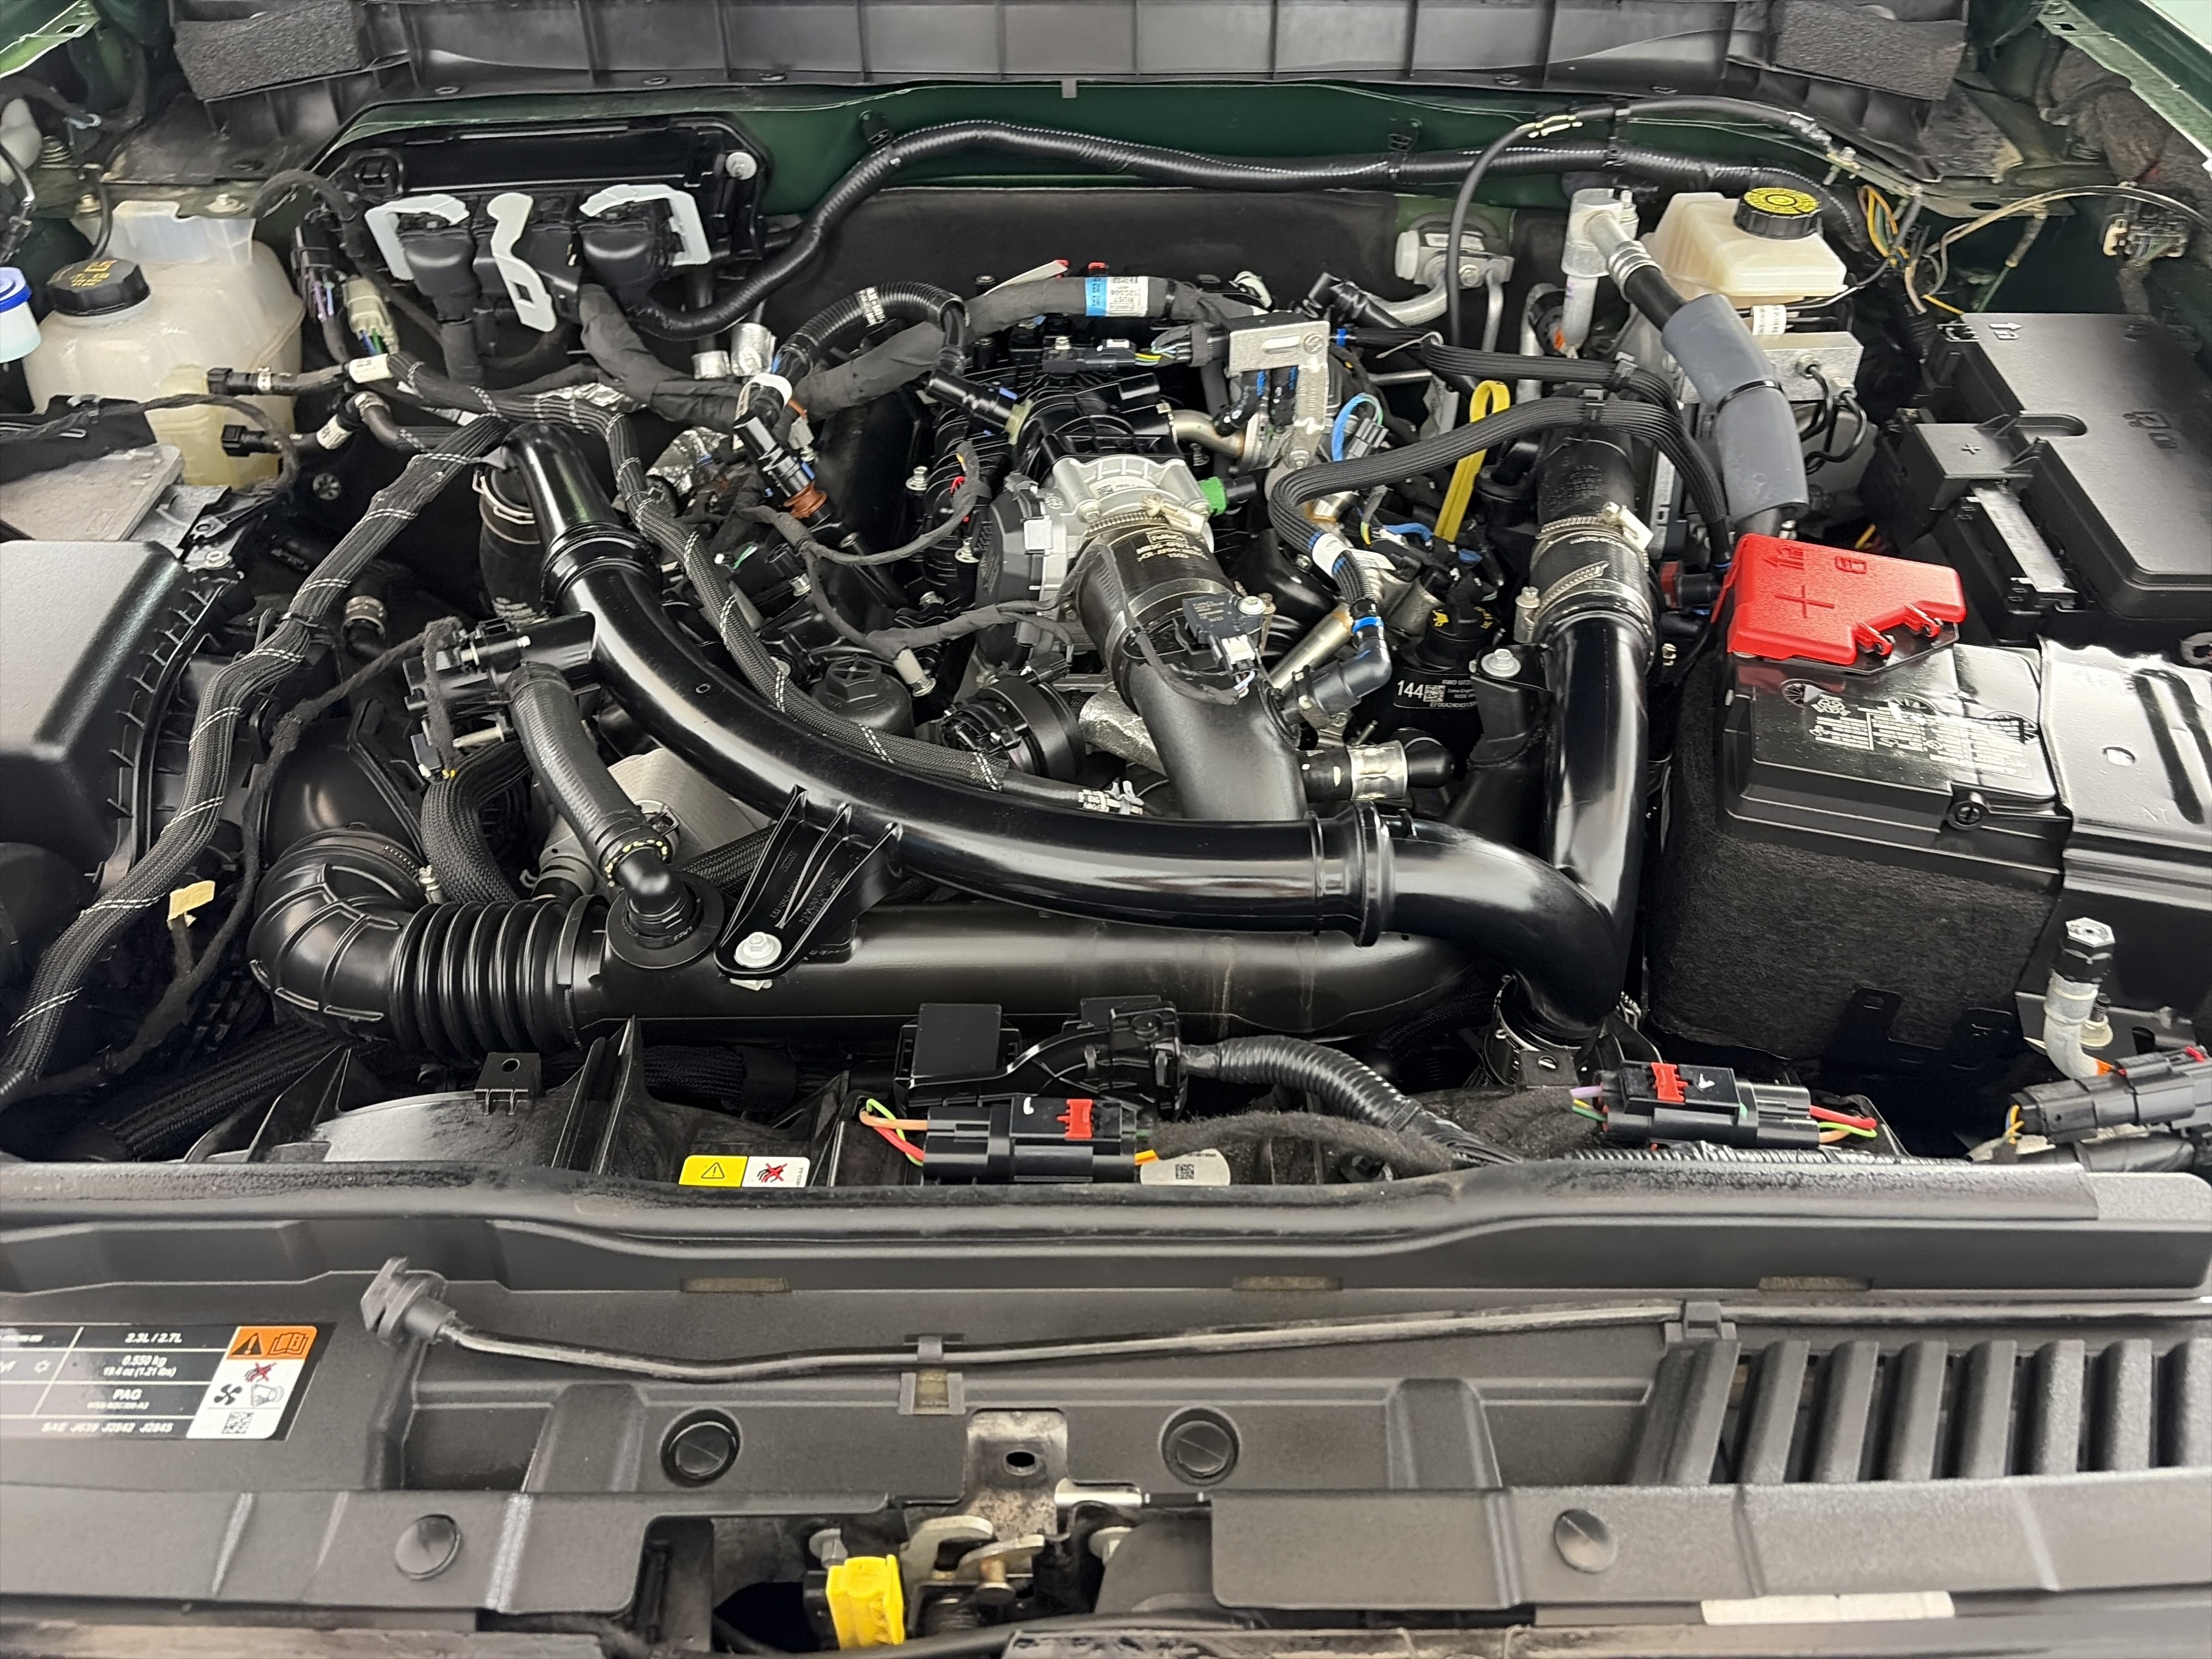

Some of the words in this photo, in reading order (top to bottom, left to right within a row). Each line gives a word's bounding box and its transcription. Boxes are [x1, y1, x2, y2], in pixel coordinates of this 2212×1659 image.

[1397, 680, 1424, 699] 144
[125, 1333, 150, 1343] 2.3L
[157, 1333, 183, 1343] 2.7L
[152, 1355, 167, 1368] kg
[112, 1388, 143, 1400] PAG
